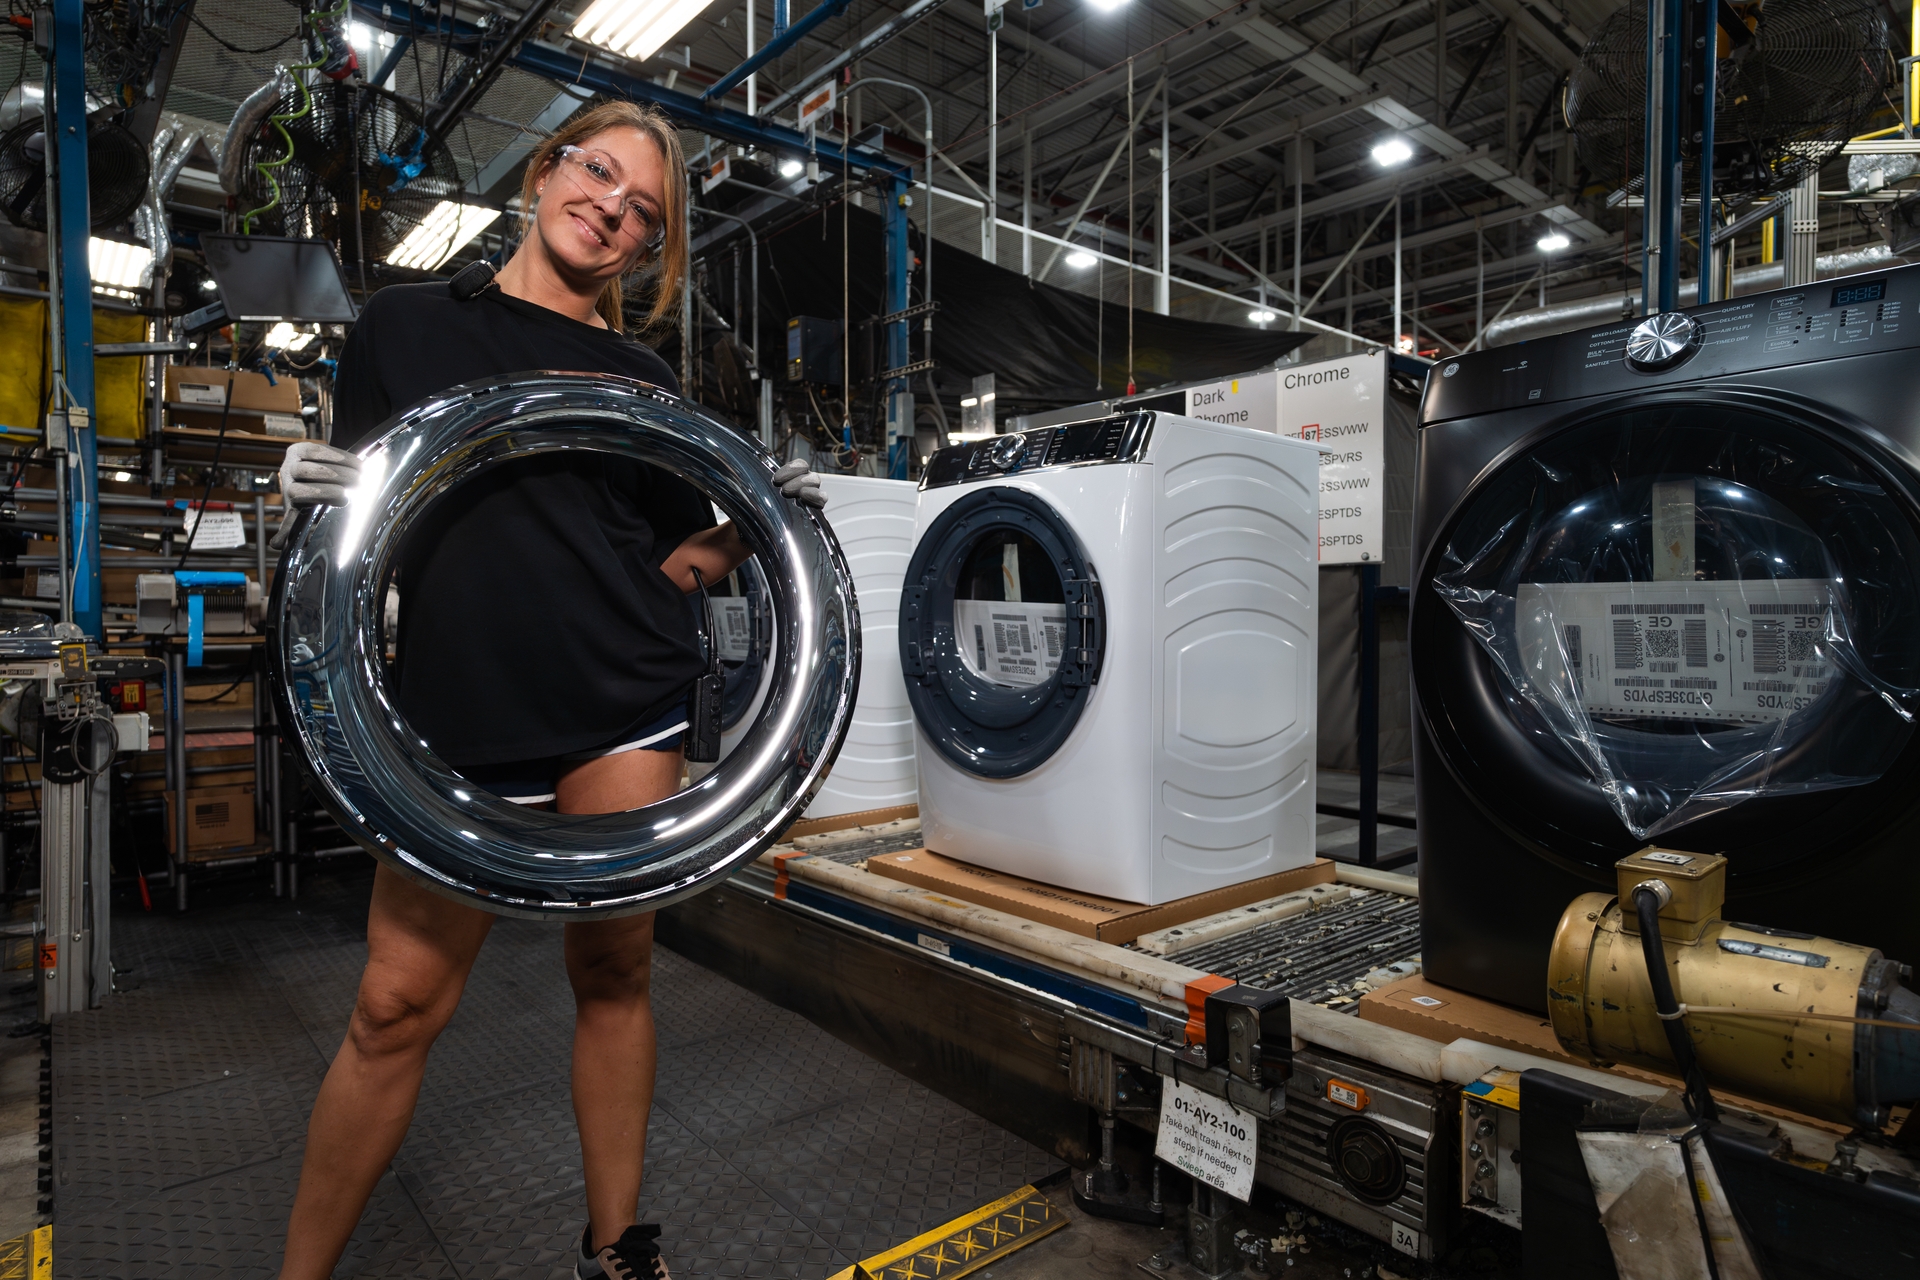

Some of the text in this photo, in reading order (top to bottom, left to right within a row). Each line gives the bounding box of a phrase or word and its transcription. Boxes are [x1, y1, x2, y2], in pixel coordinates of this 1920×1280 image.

[1720, 314, 1753, 323] DELICATES
[1591, 328, 1628, 338] MIXED LOADS
[1589, 339, 1615, 348] COTTONS
[1585, 360, 1610, 369] SANITIZE
[1284, 366, 1350, 389] Chrome
[1193, 389, 1225, 406] Dark
[1194, 410, 1248, 424] hrome
[1648, 616, 1672, 627] GE
[1794, 617, 1821, 629] GE
[1633, 620, 1644, 668] VA100233G
[1624, 689, 1713, 704] GFD35ESPYDS
[1758, 694, 1814, 710] ESPYDS
[956, 865, 997, 880] FRONT
[1174, 1098, 1246, 1141] 01-AY2-100
[1165, 1114, 1252, 1165] Take out trash next to
[1174, 1136, 1237, 1175] steps if needed
[1177, 1155, 1224, 1188] Sweep area
[1397, 1230, 1413, 1250] 3A
